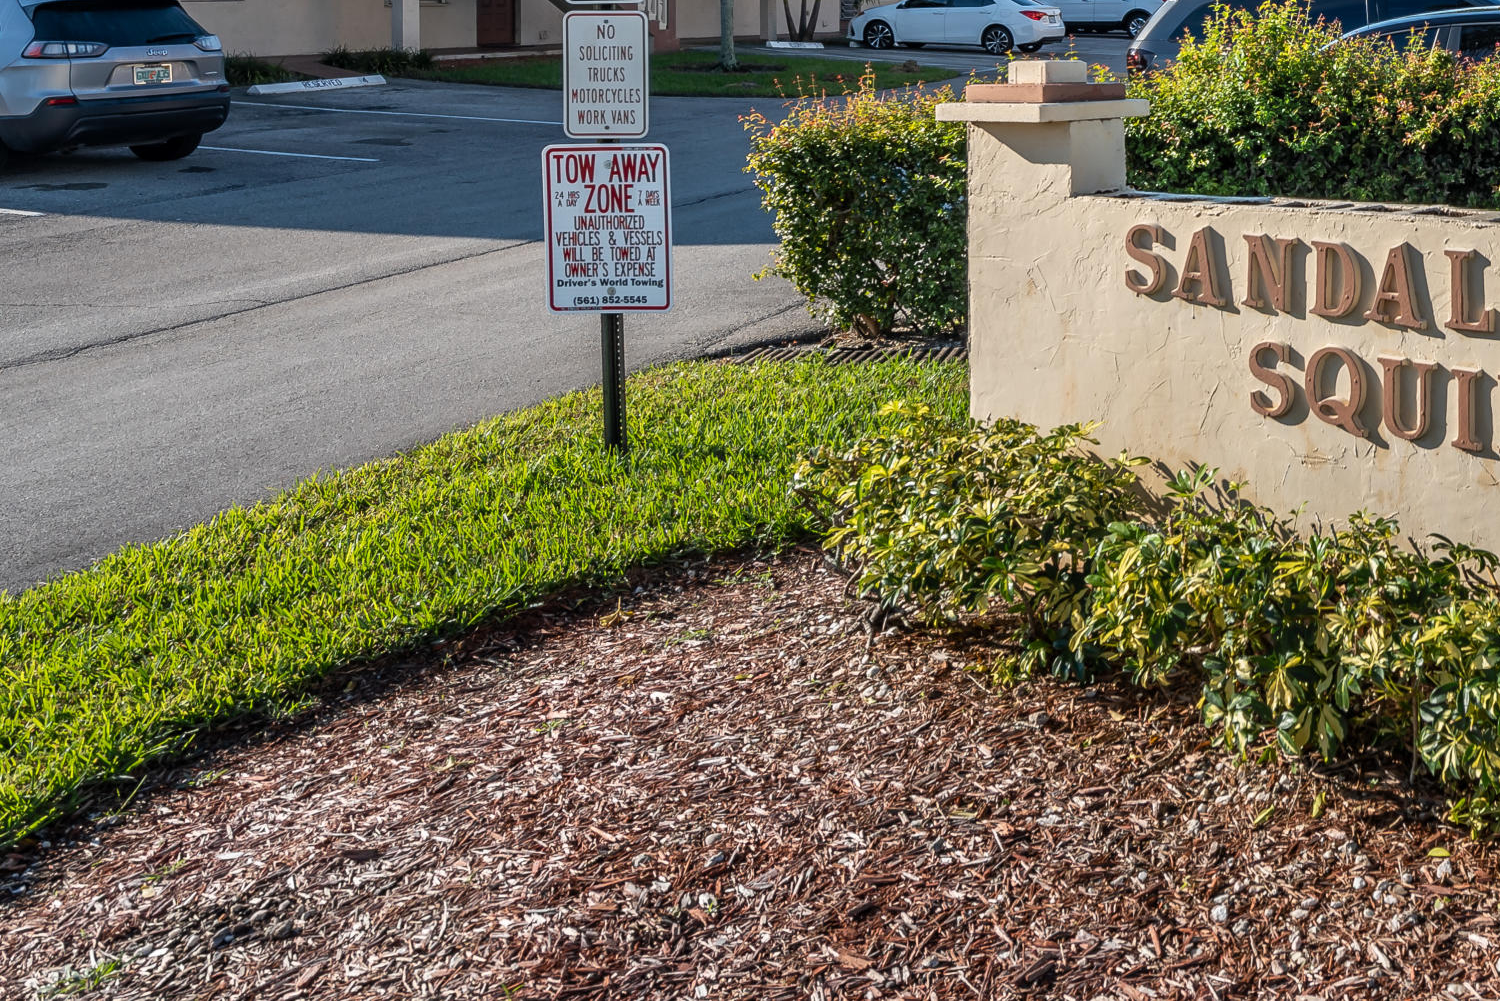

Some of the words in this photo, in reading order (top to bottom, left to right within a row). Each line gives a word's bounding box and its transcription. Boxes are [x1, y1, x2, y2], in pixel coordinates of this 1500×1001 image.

[597, 24, 616, 40] NO
[579, 45, 633, 61] SOLICITING
[587, 66, 625, 82] TRUCKS
[302, 79, 343, 89] RESERVED
[571, 88, 641, 104] MOTORCYCLES
[577, 110, 606, 125] WORK
[611, 109, 636, 124] VANS
[552, 154, 596, 183] TOW
[608, 153, 660, 182] AWAY
[554, 191, 564, 199] 24
[568, 191, 580, 199] HRS
[584, 184, 635, 213] ZONE
[638, 190, 642, 198] 7
[646, 190, 660, 198] DAYS
[566, 199, 578, 207] DAY
[573, 215, 645, 230] UNAUTHORIZED
[556, 231, 600, 246] VEHICLES
[608, 231, 617, 245] &
[623, 231, 663, 245] VESSELS
[563, 247, 585, 262] WILL
[592, 247, 604, 261] BE
[610, 246, 641, 261] TOWED
[647, 246, 656, 261] AT
[565, 262, 608, 278] OWNER'S
[614, 262, 656, 277] EXPENSE
[557, 278, 597, 287] Driver's
[600, 278, 628, 286] World
[631, 278, 664, 288] Towing
[573, 296, 599, 305] (561)
[602, 296, 648, 304] 852-5545
